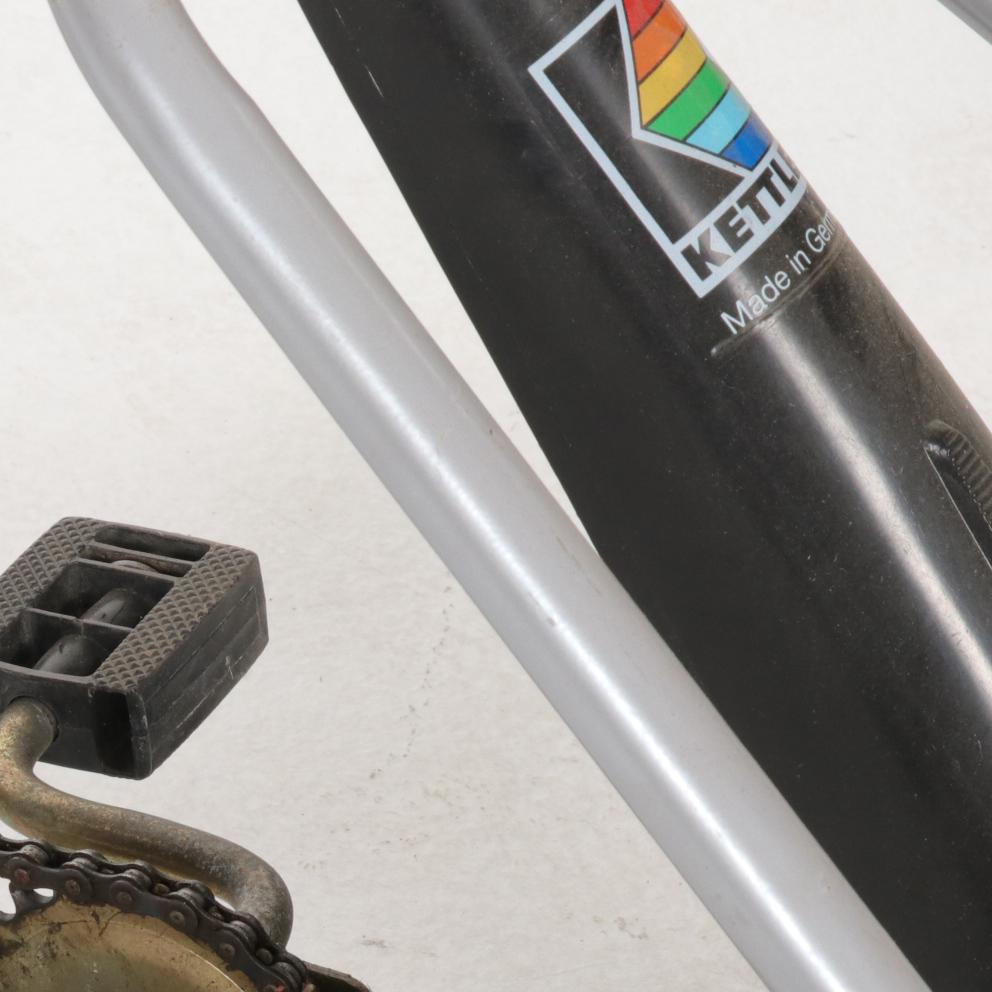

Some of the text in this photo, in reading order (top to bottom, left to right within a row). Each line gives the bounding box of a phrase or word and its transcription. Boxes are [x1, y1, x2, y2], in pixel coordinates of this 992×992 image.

[680, 156, 800, 283] KETTL
[720, 270, 791, 335] Made
[784, 248, 812, 276] in
